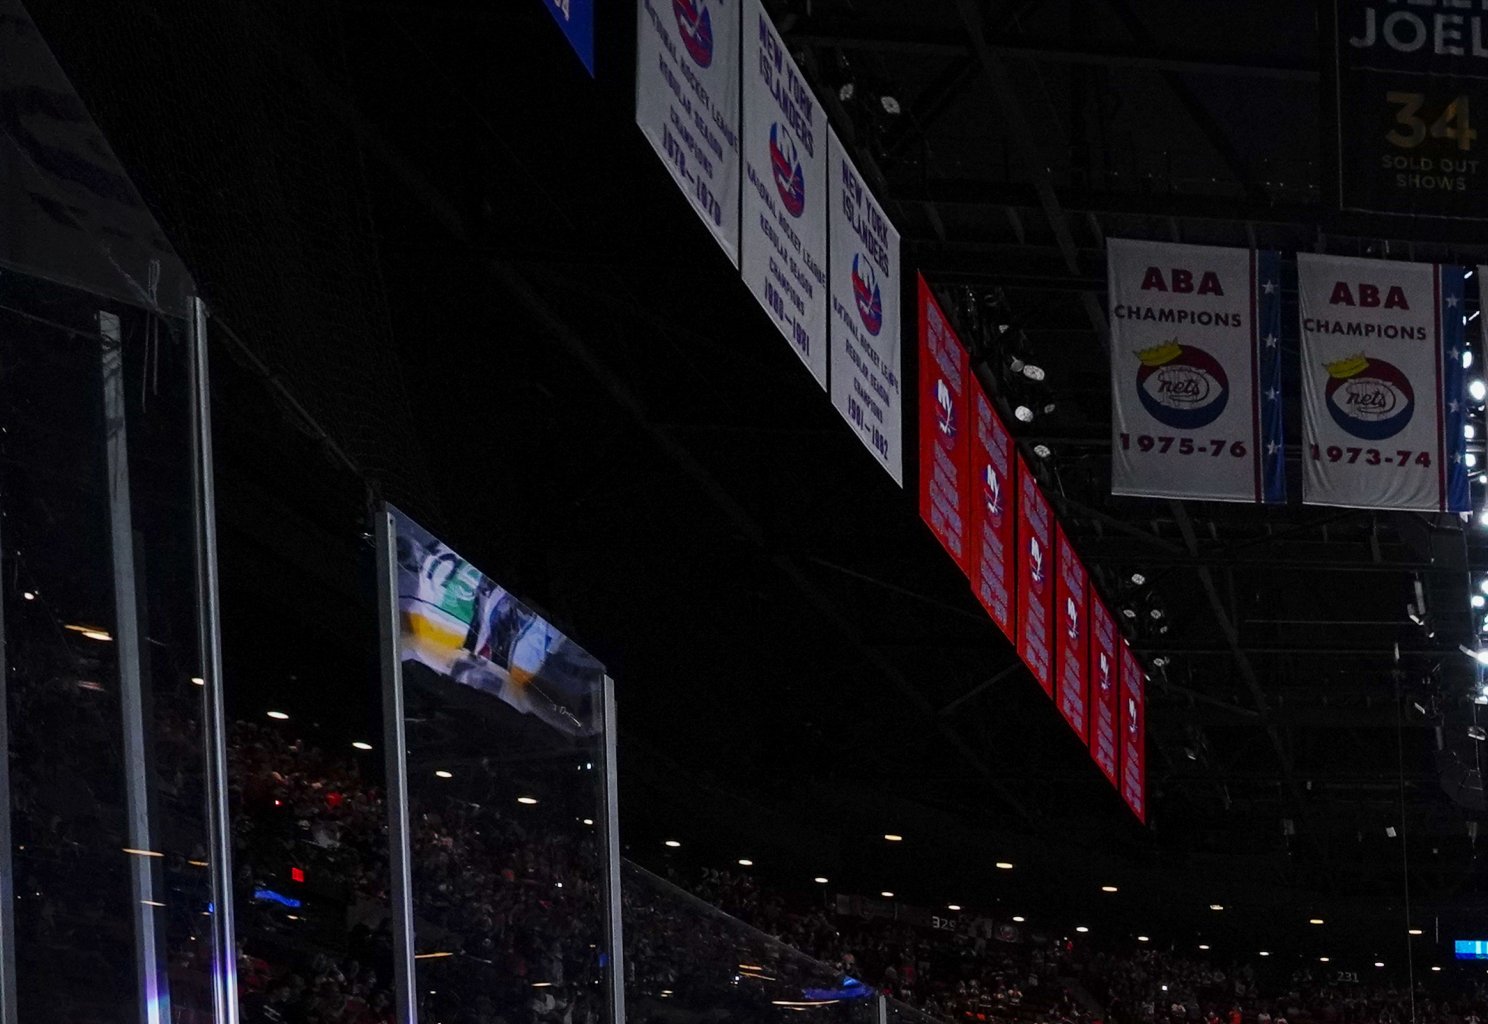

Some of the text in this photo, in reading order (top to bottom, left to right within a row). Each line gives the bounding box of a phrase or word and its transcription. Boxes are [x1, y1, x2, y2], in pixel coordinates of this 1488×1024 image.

[759, 13, 813, 128] NEW YORK
[760, 47, 814, 159] ISLANDERS
[1384, 91, 1478, 151] 34
[1381, 154, 1479, 176] SOLD OUT
[1395, 173, 1467, 192] SHOWS
[842, 159, 889, 250] NEW YORK
[842, 188, 889, 278] ISLANDERS
[1141, 266, 1225, 297] ABA
[1329, 281, 1410, 311] ABA
[1114, 304, 1242, 328] CHAMPIONS
[1303, 318, 1428, 341] CHAMPIONS
[1120, 433, 1248, 459] 1975-76
[1310, 443, 1432, 469] 1973-74
